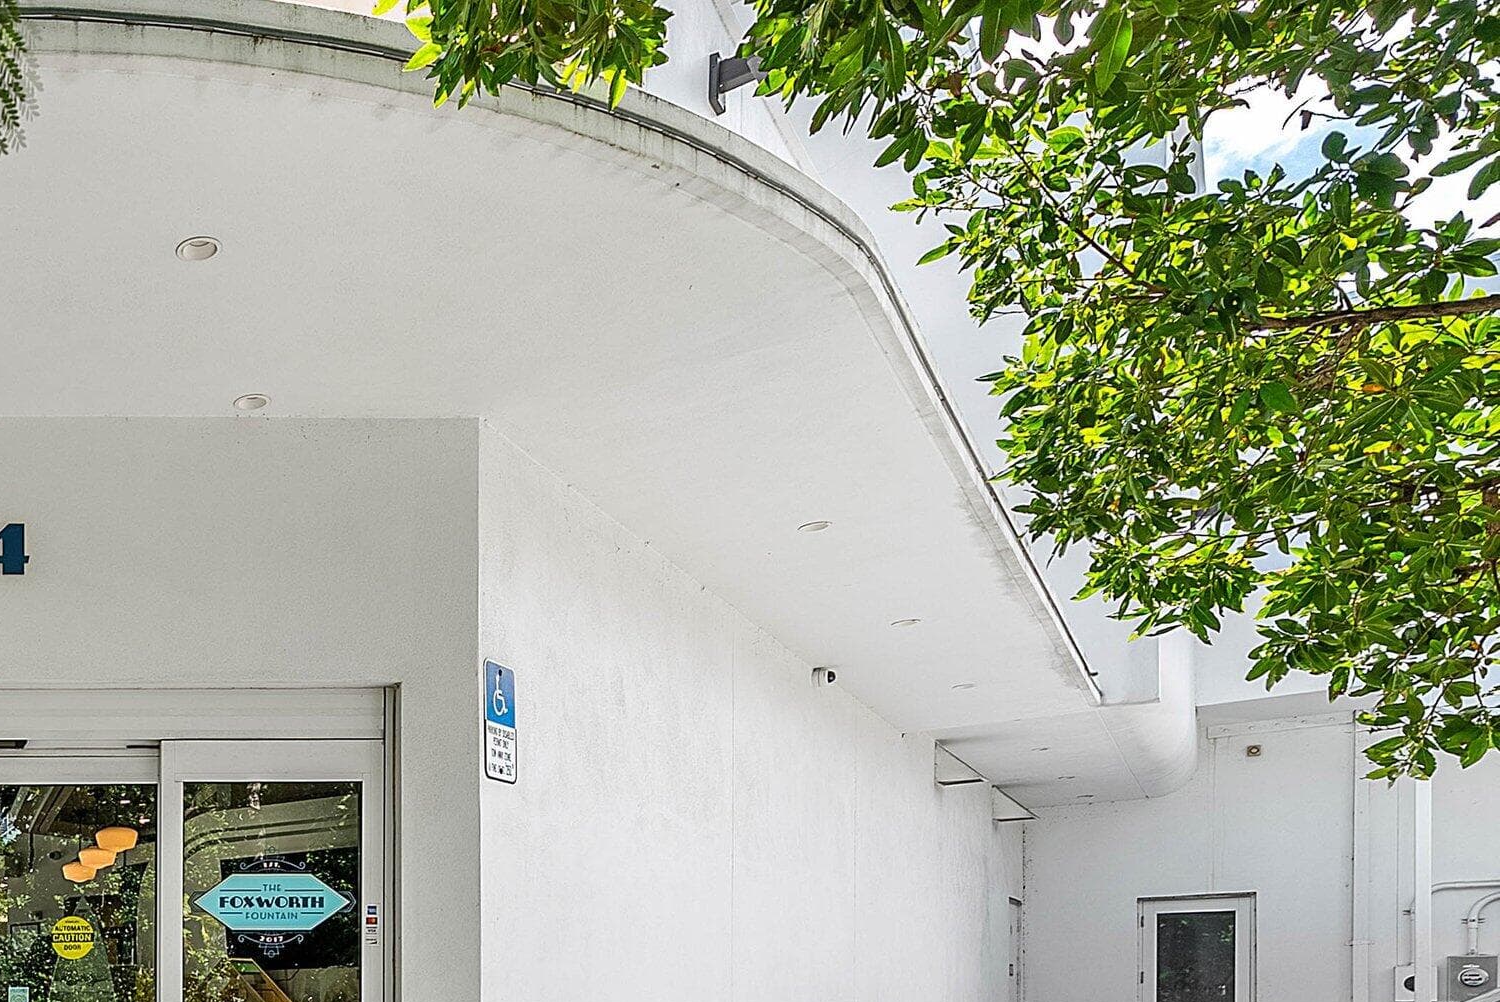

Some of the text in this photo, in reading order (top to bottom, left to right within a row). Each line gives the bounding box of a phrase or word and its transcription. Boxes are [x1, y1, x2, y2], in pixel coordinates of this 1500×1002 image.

[262, 884, 281, 892] THE
[219, 895, 324, 908] FOXWORTH
[245, 912, 298, 920] FOUNTAIN
[52, 934, 92, 942] CAUTION
